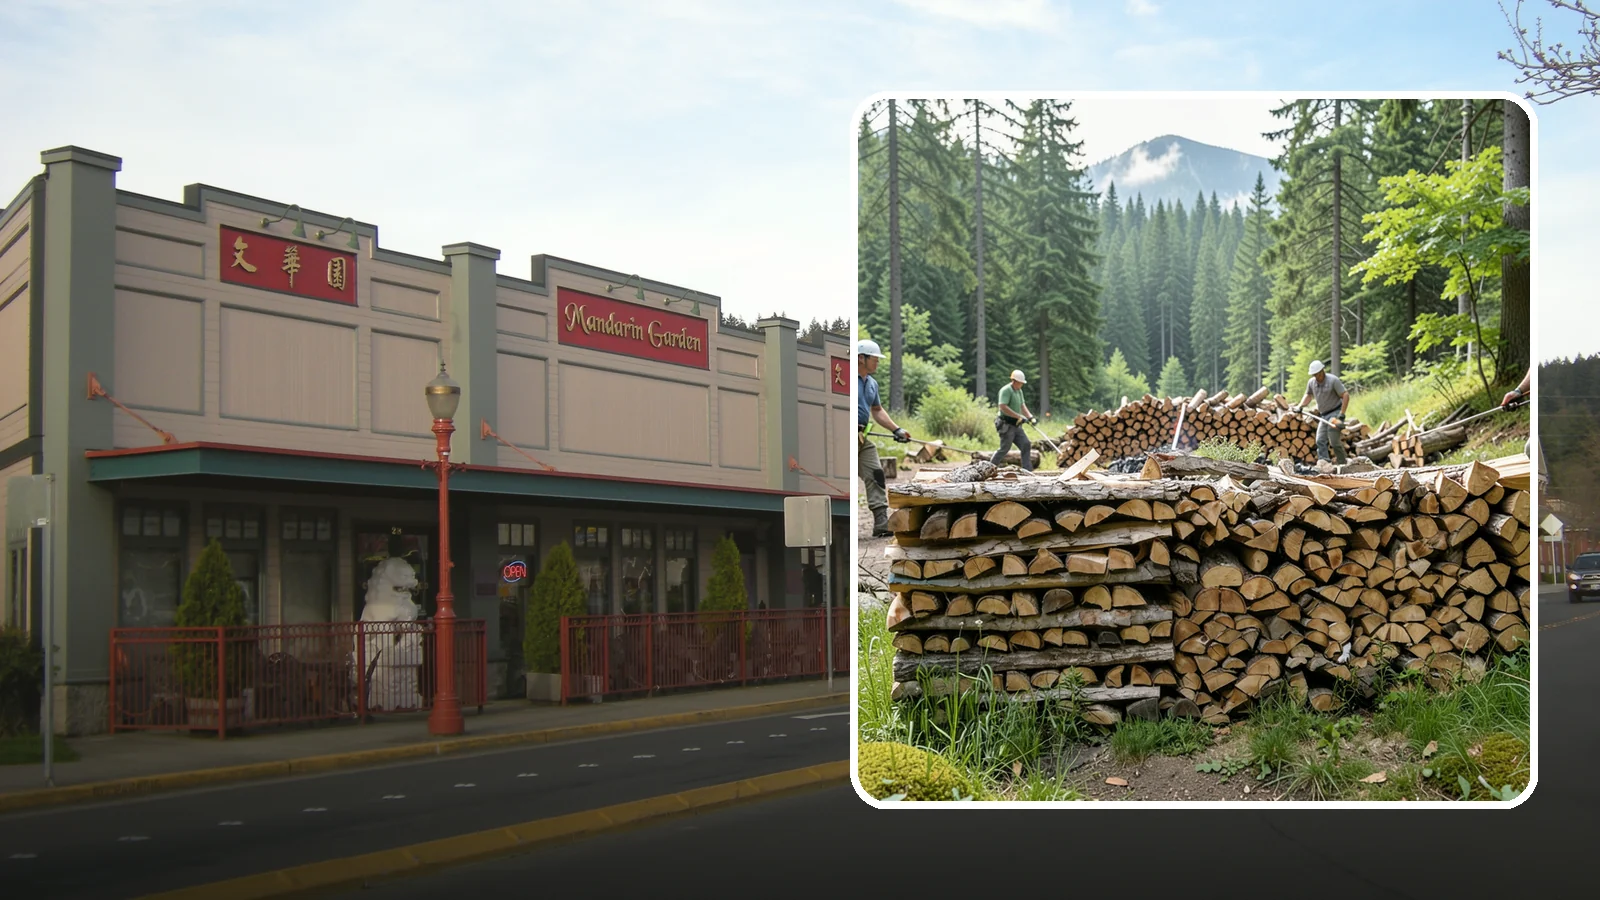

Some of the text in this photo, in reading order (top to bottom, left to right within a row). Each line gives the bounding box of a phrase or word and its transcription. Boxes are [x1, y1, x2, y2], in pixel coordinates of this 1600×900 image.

[564, 302, 701, 352] Mandarin Garden
[503, 565, 527, 578] OPEN
